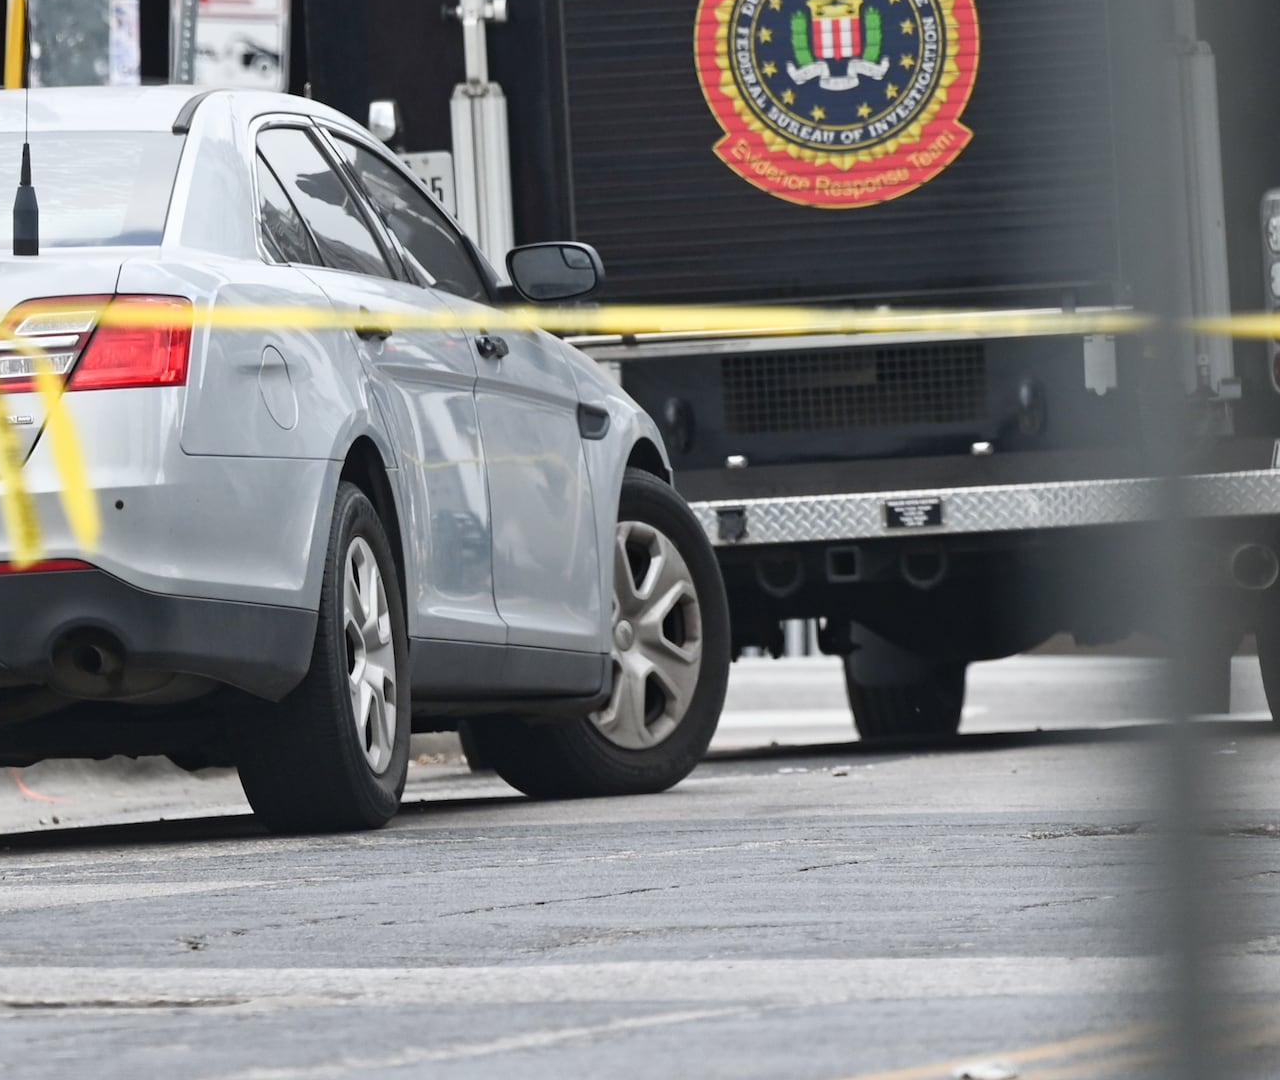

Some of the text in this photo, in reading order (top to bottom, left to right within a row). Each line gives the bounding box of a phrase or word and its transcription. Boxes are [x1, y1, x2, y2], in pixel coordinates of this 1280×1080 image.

[736, 16, 938, 145] FEDERAL BUREAU OF INVESTIGATION
[730, 129, 957, 200] Evidence Response Team
